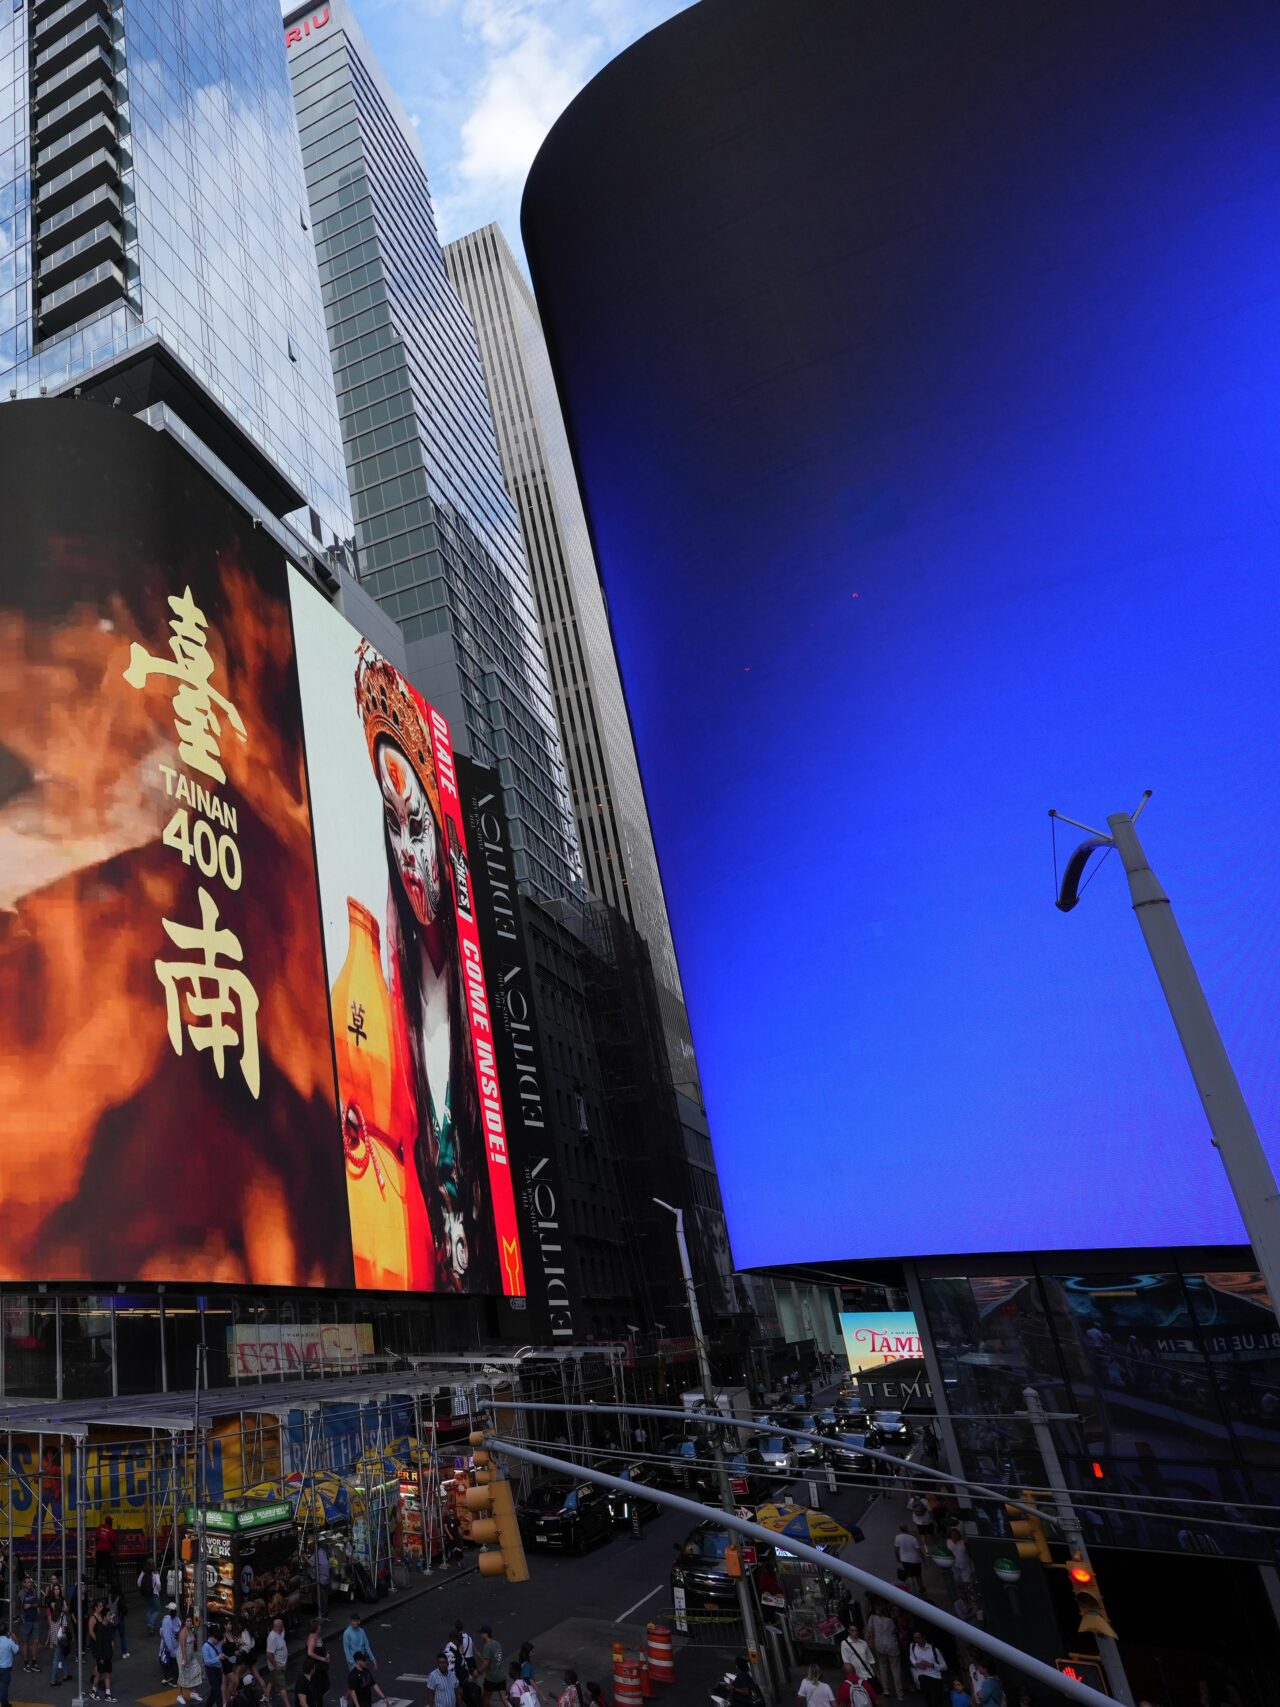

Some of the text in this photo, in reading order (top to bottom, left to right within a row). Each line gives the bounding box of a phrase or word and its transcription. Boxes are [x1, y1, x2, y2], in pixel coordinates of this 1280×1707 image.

[285, 7, 330, 48] RIU
[159, 764, 238, 835] TAINAN
[162, 810, 243, 891] 400
[155, 886, 261, 1100] 南
[463, 938, 507, 1166] COME INSIDE!
[502, 961, 545, 1128] EDITION
[529, 1155, 574, 1336] EDITION
[855, 1328, 924, 1353] TAM
